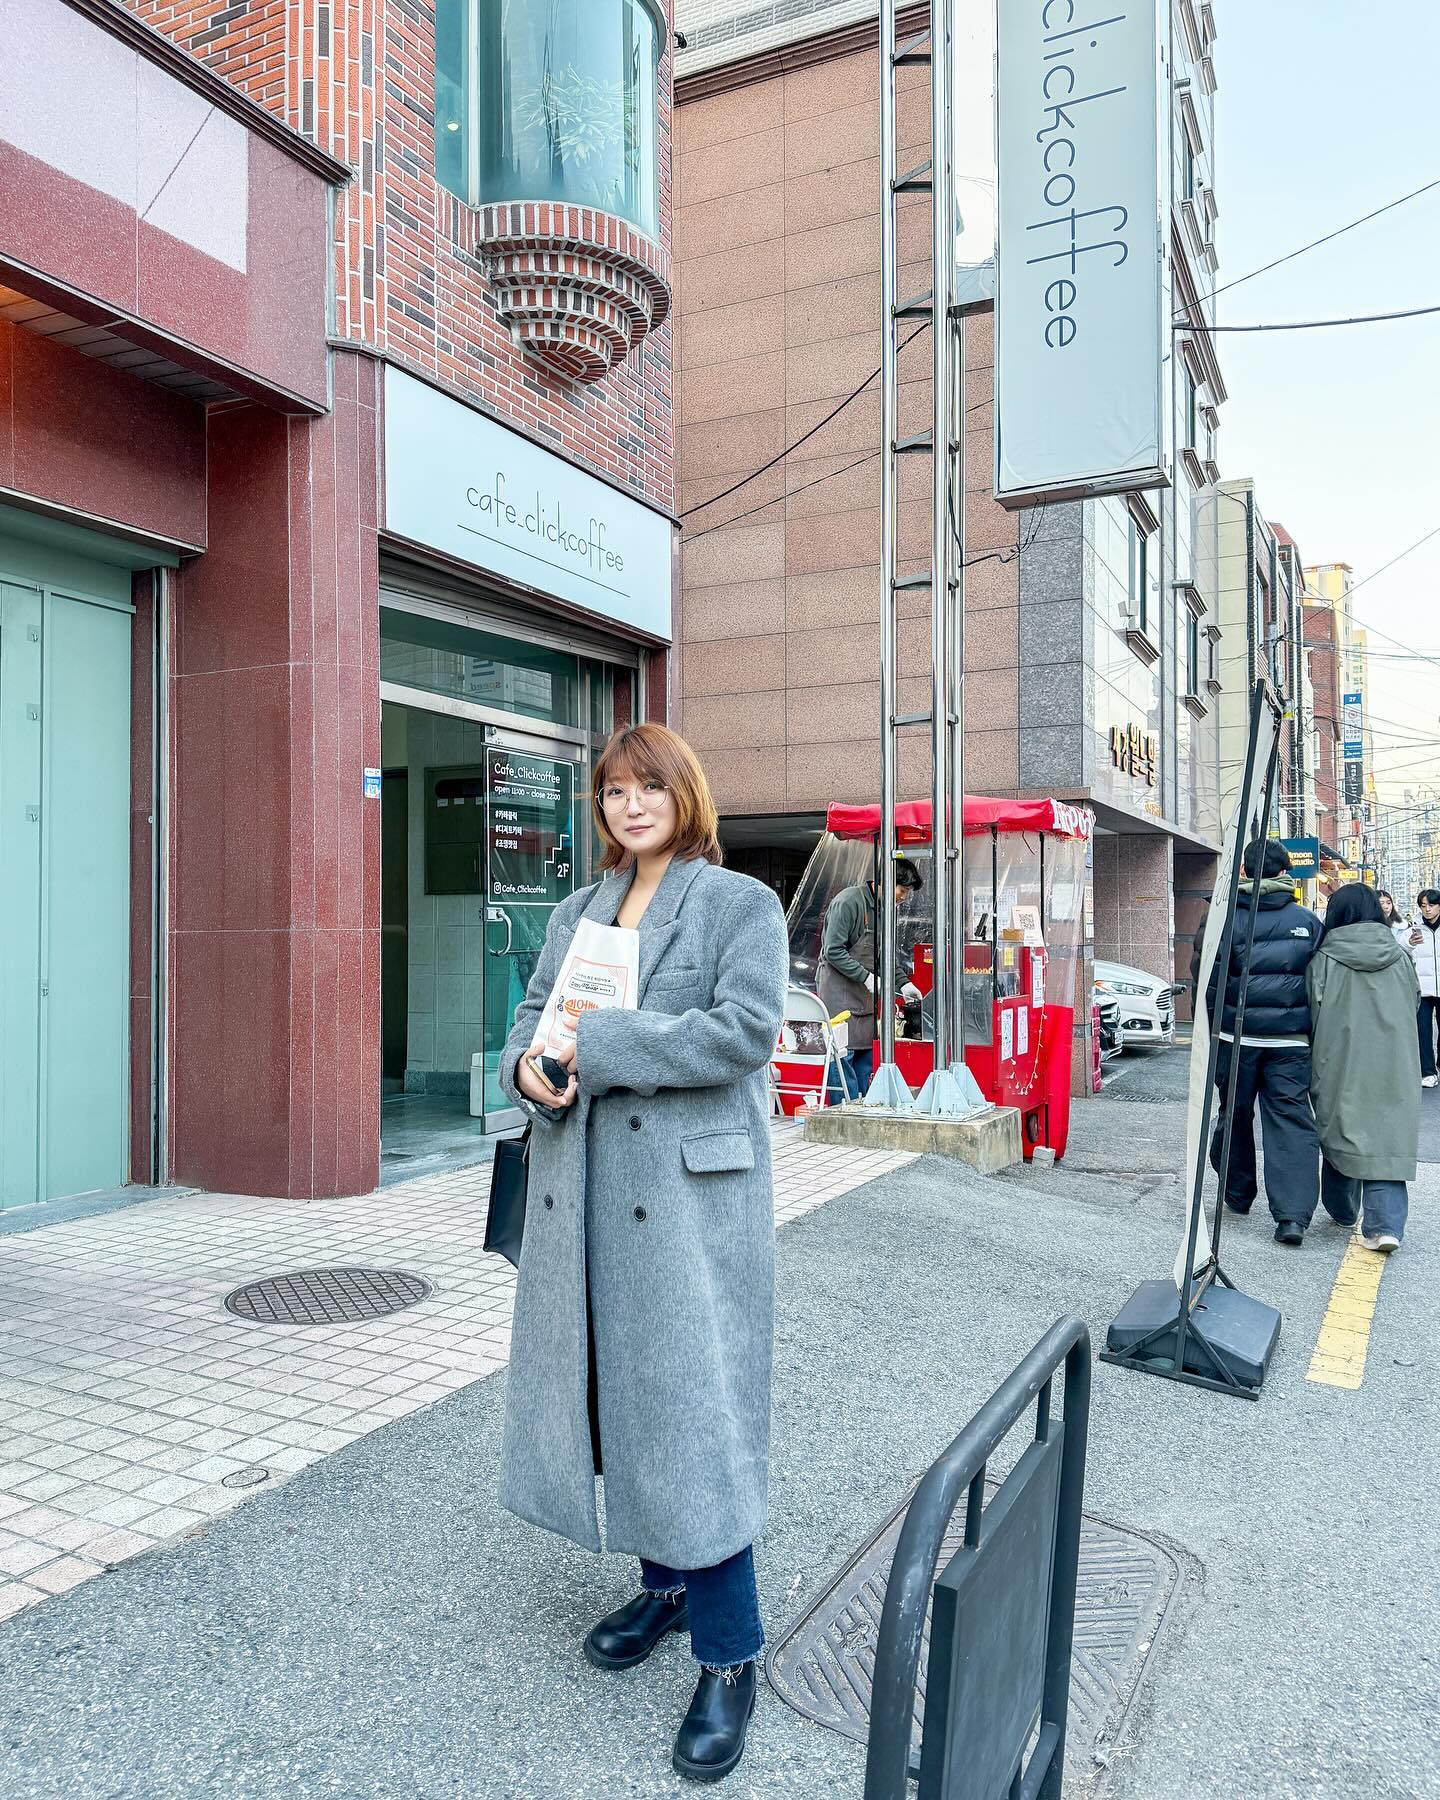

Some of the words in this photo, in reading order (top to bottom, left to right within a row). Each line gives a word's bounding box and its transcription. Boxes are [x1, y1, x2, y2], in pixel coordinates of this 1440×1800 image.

[466, 472, 624, 572] cafe_clickcoffee
[494, 762, 561, 784] Cafe_Clickcoffee
[494, 785, 510, 795] open
[511, 787, 525, 796] 11:00
[531, 789, 546, 799] close
[547, 792, 560, 801] 22:00
[557, 863, 570, 878] 2F
[501, 883, 547, 894] Cafe_Clickcoffee
